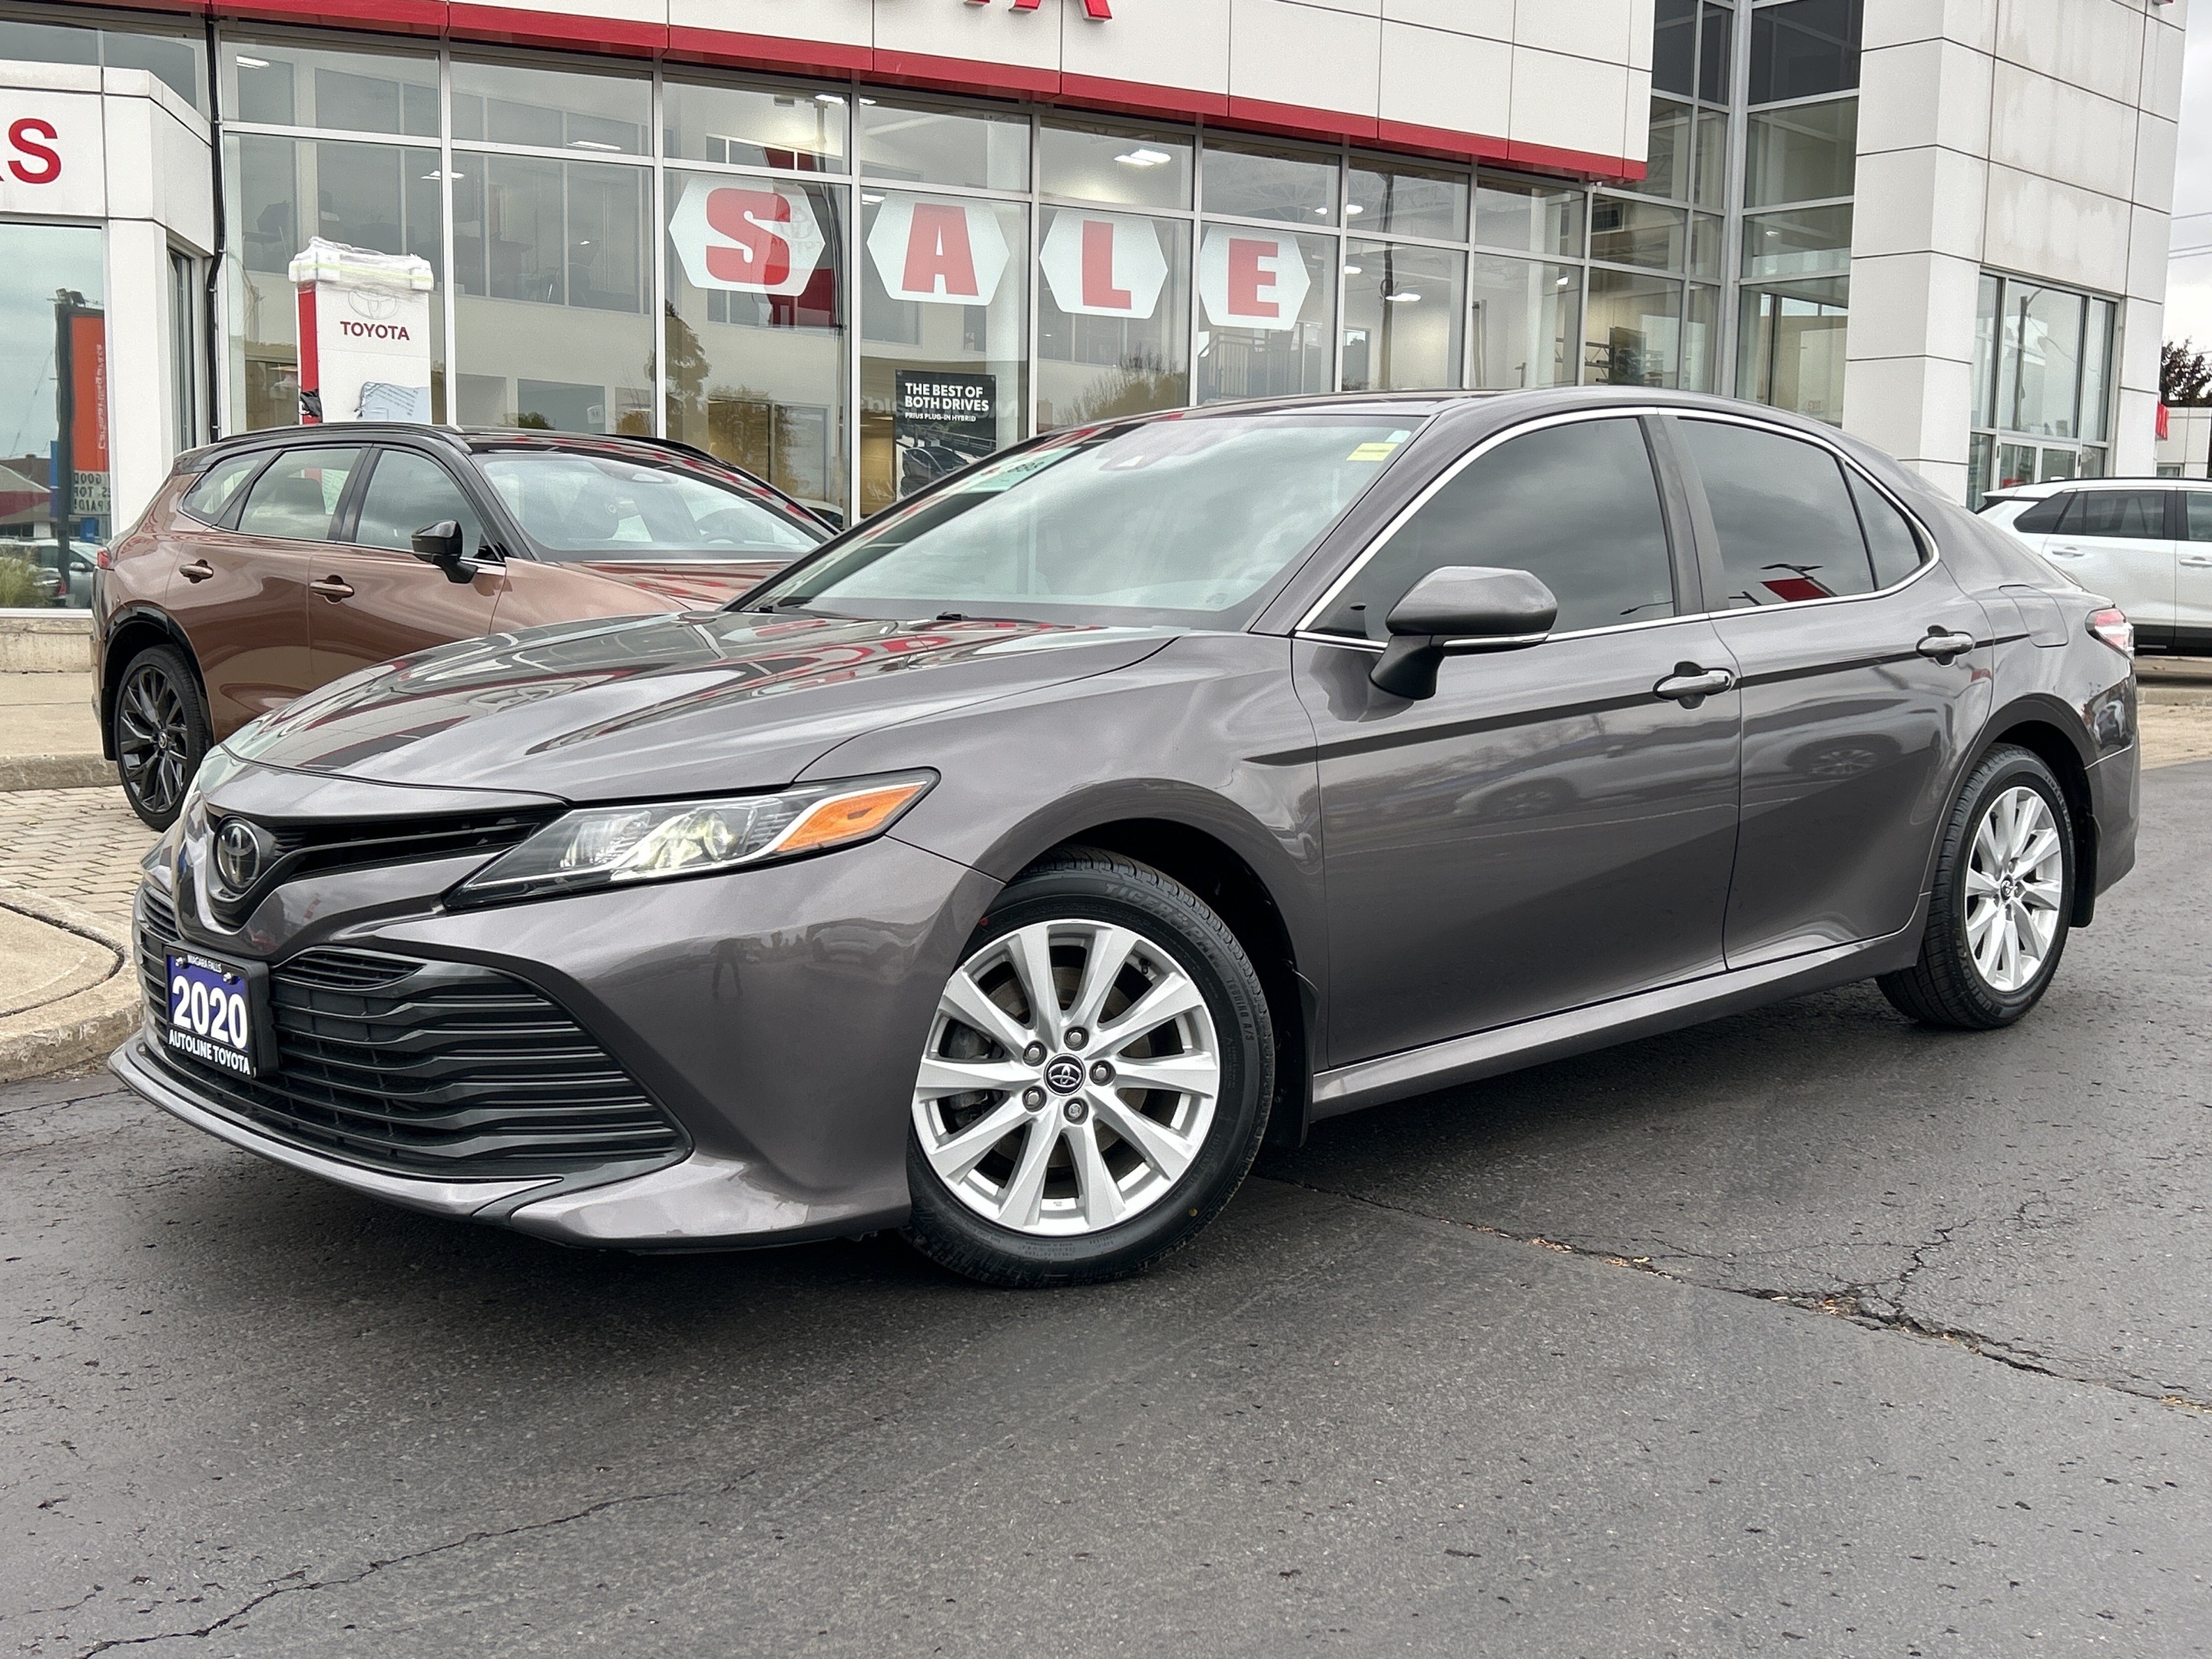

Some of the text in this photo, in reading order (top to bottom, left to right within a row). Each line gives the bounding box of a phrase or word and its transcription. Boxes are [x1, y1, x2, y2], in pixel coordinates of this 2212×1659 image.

[339, 321, 410, 340] TOYOTA
[905, 382, 983, 399] THE BEST OF
[905, 396, 940, 409] BOTH
[942, 398, 989, 412] DRIVES
[187, 954, 222, 973] NIAGARA FALLS
[172, 975, 247, 1049] 2020
[169, 1029, 251, 1075] AUTOLINE TOYOTA
